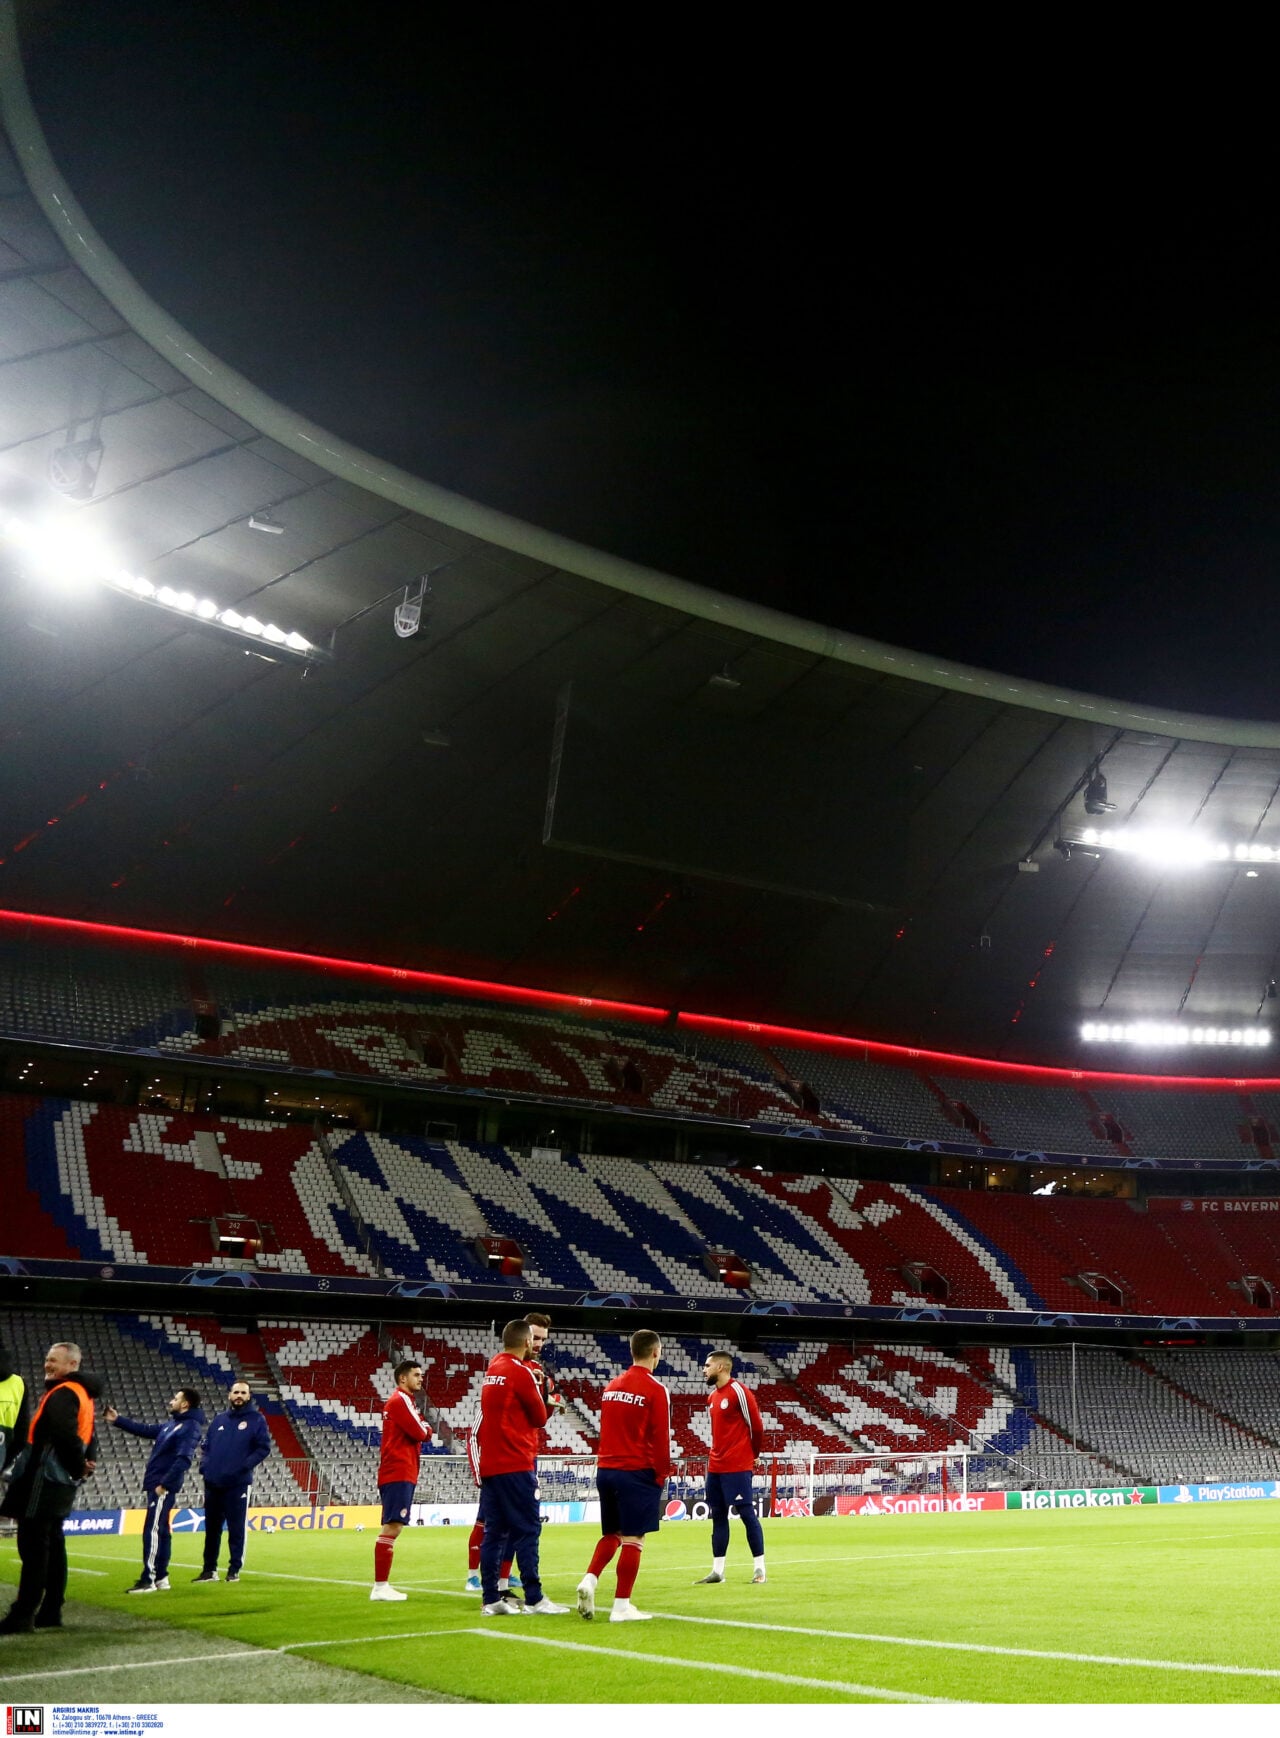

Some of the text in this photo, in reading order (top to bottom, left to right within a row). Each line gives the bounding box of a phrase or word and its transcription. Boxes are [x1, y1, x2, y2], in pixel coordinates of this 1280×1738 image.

[1201, 1201, 1220, 1212] FC
[1223, 1201, 1280, 1212] BAYERN
[633, 1395, 646, 1407] FC
[1021, 1487, 1126, 1510] Heineken
[1199, 1484, 1264, 1501] PlayStation
[768, 1497, 815, 1518] MAX
[883, 1495, 985, 1515] Santander
[81, 1518, 114, 1531] GAME
